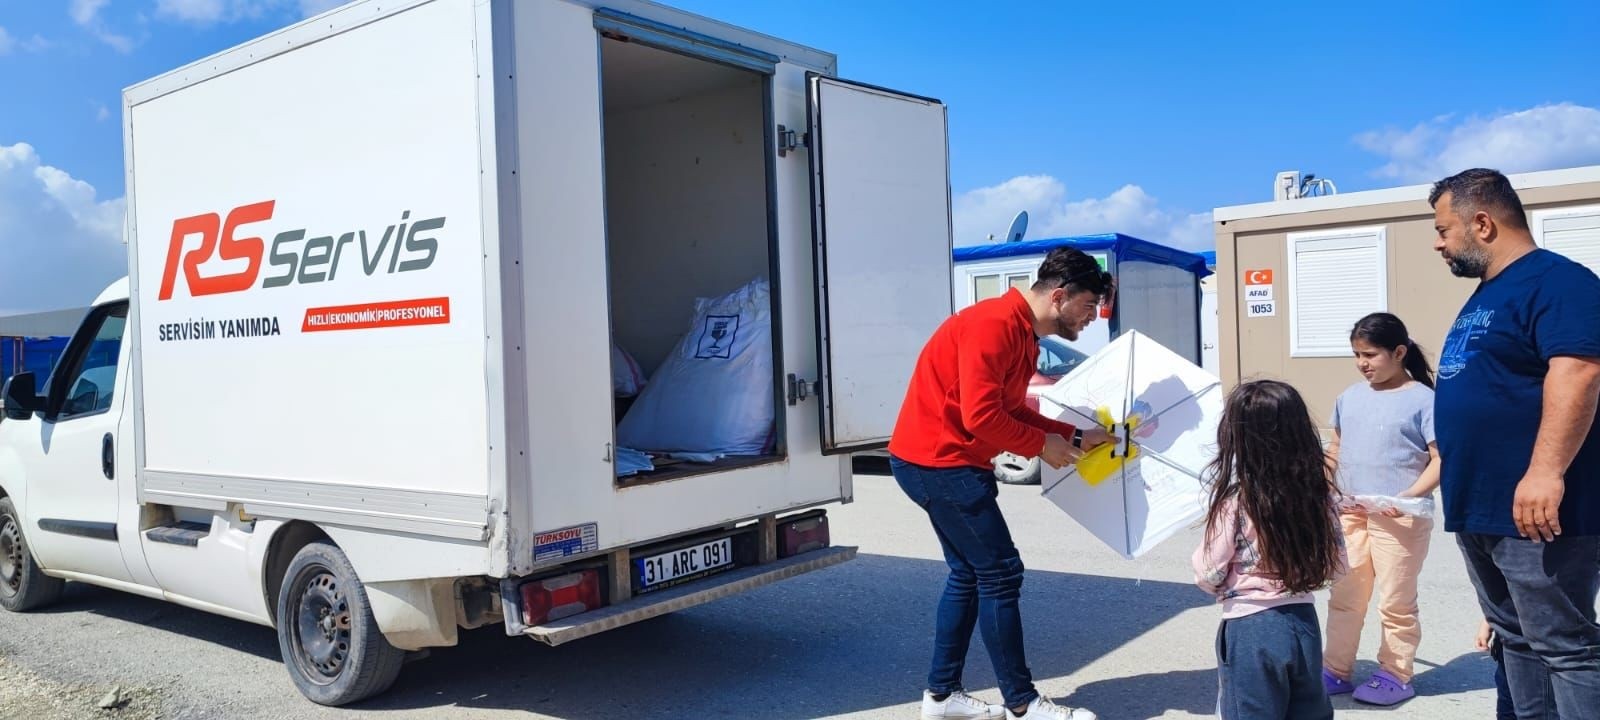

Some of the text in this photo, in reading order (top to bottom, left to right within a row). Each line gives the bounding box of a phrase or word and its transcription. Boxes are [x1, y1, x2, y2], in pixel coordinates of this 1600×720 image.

[1251, 304, 1272, 314] 1053
[159, 317, 280, 341] SERVİSİM YANIMDA
[646, 557, 663, 583] 31
[672, 549, 698, 577] ARC
[703, 541, 727, 567] 091
